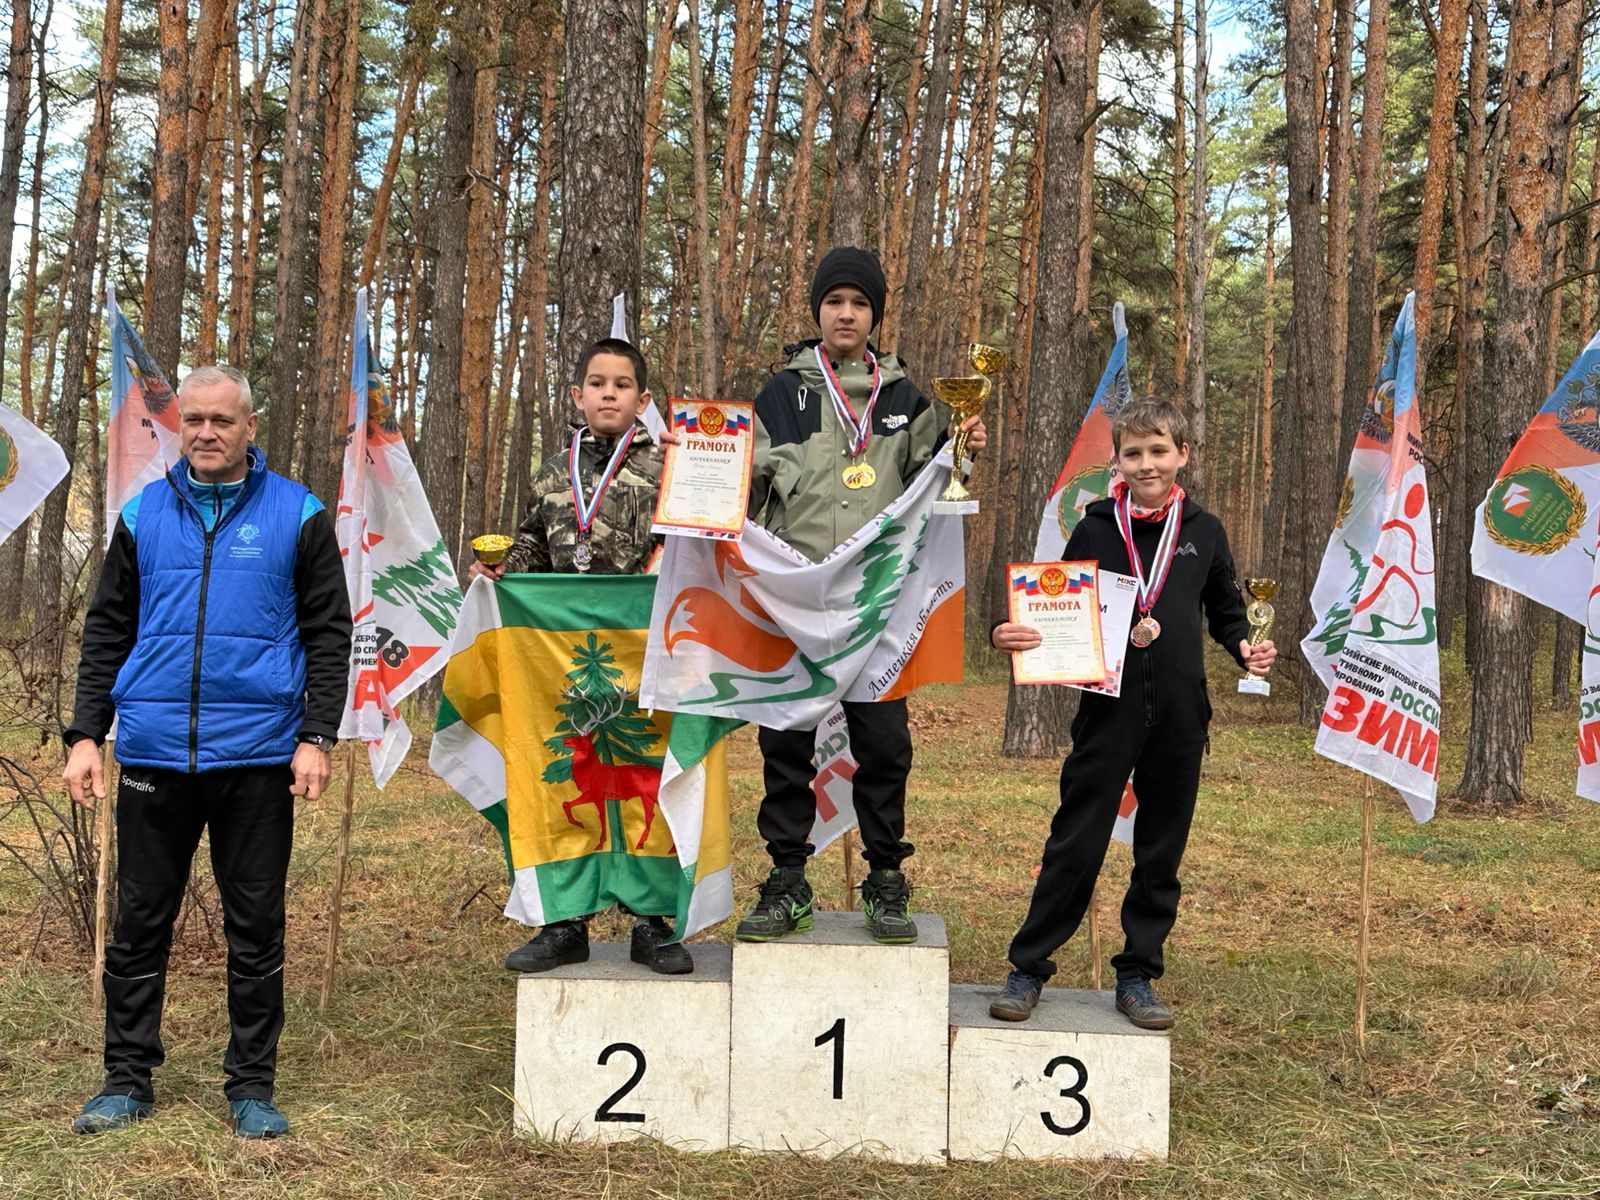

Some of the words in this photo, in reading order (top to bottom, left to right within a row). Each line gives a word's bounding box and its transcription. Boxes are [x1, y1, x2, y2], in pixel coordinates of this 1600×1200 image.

[686, 440, 737, 453] ГРАМОТА
[1028, 600, 1082, 612] ГРАМОТА
[1321, 685, 1440, 780] ЗИМ
[121, 774, 156, 793] Sportlife
[594, 1042, 647, 1123] 2
[814, 1017, 846, 1100] 1
[1040, 1055, 1092, 1136] 3
